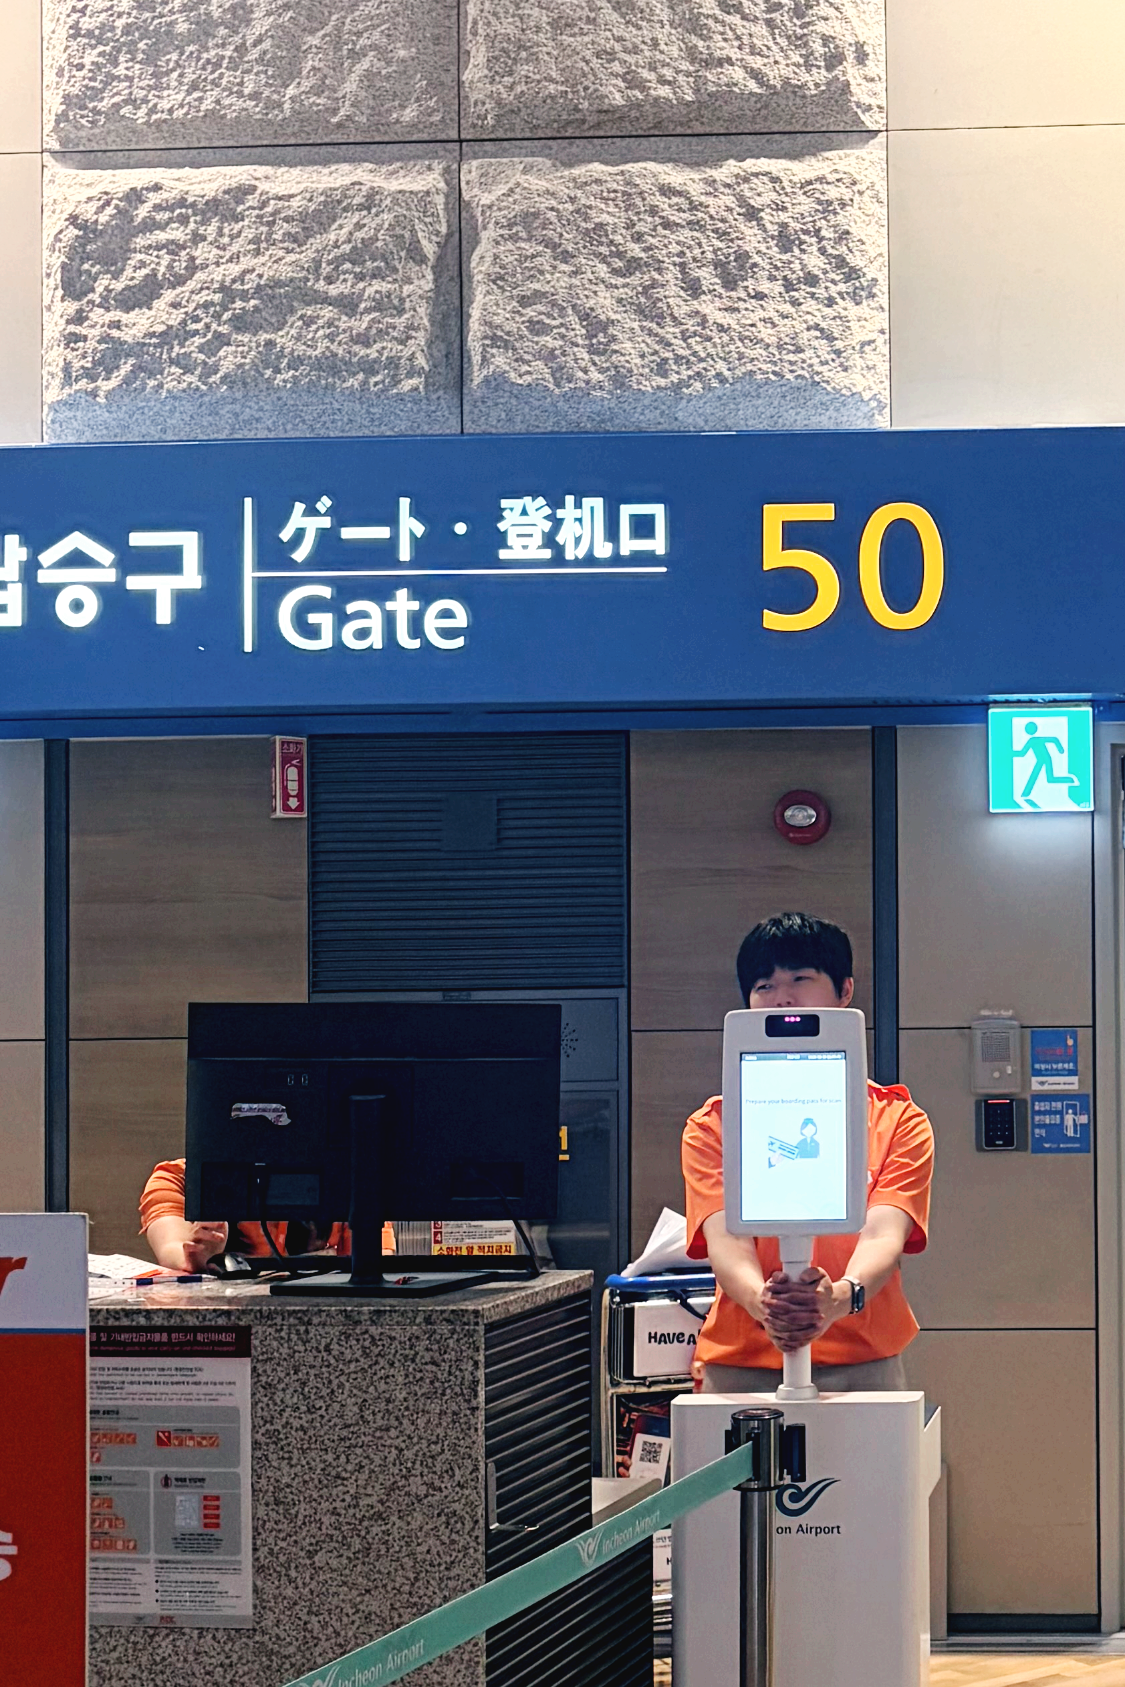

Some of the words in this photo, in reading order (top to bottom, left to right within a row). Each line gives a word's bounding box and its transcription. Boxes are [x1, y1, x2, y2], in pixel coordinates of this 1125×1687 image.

[279, 495, 426, 562] ゲート
[497, 495, 667, 560] 登机口
[762, 501, 945, 632] 50
[278, 585, 469, 651] Gate
[796, 1523, 841, 1537] Airport
[387, 1639, 425, 1673] Airport
